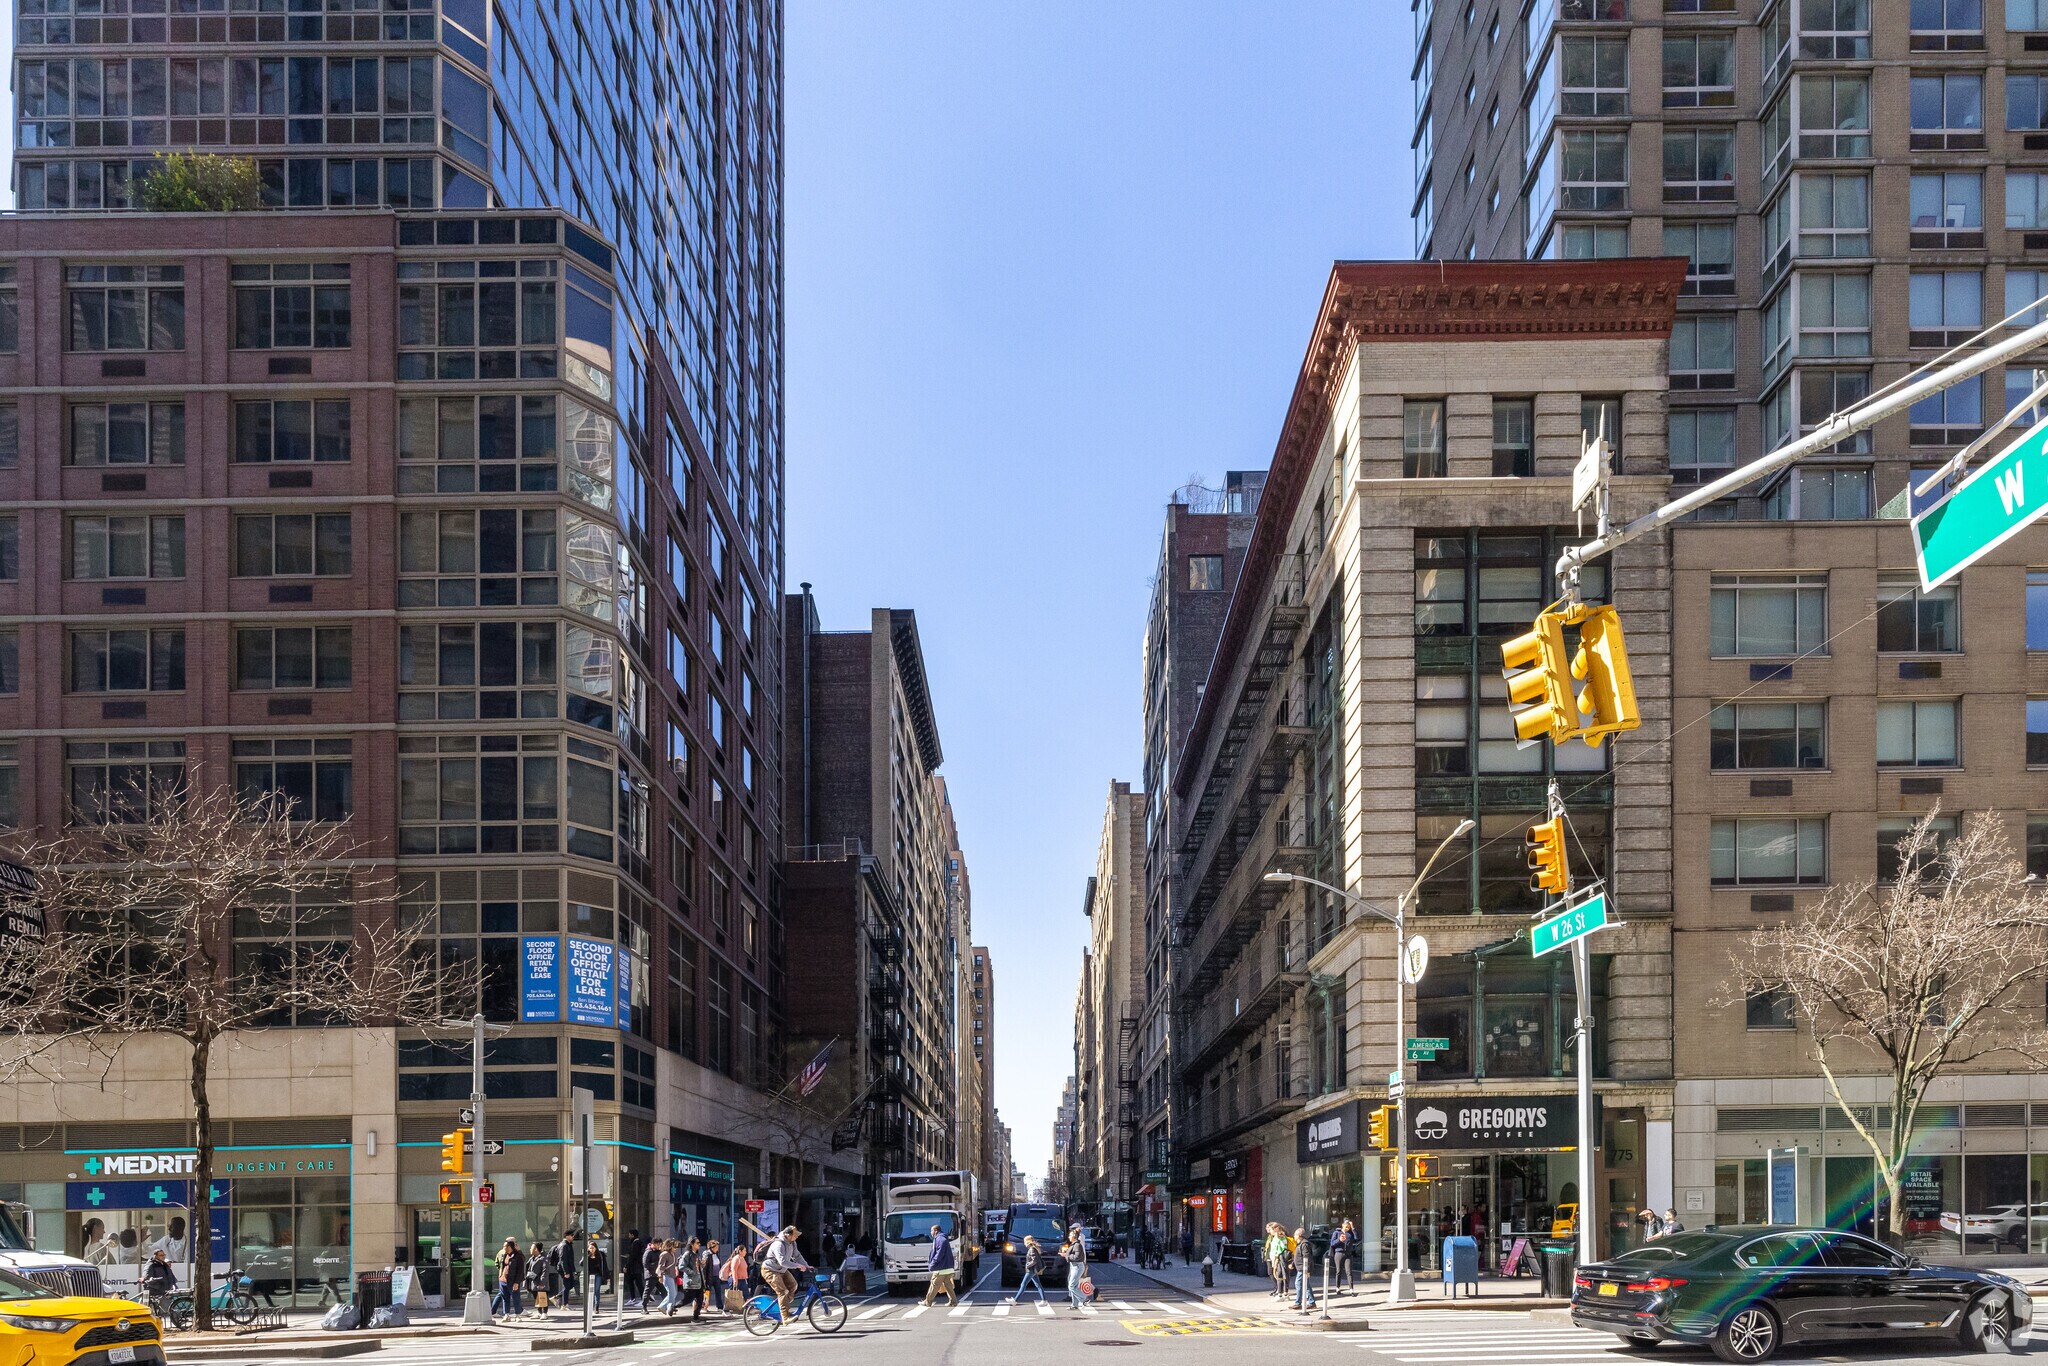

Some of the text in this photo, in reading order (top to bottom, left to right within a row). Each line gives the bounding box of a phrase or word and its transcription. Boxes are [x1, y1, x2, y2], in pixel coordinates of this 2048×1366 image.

[1994, 459, 2025, 517] W
[1550, 911, 1586, 942] W 26 St
[569, 940, 612, 955] SECOND
[573, 949, 608, 963] FLOOR
[570, 958, 611, 973] OFFICE/
[574, 967, 608, 980] RETAIL
[580, 976, 602, 988] FOR
[575, 984, 607, 997] LEASE
[570, 1001, 612, 1012] 703.434.1461
[1412, 1050, 1418, 1059] 6
[1458, 1107, 1547, 1129] GREGORYS
[1472, 1131, 1534, 1139] COFFEE
[1611, 1149, 1633, 1161] 775
[104, 1155, 335, 1175] MEDRIT URGENT CARE
[677, 1158, 706, 1177] MEDRITE
